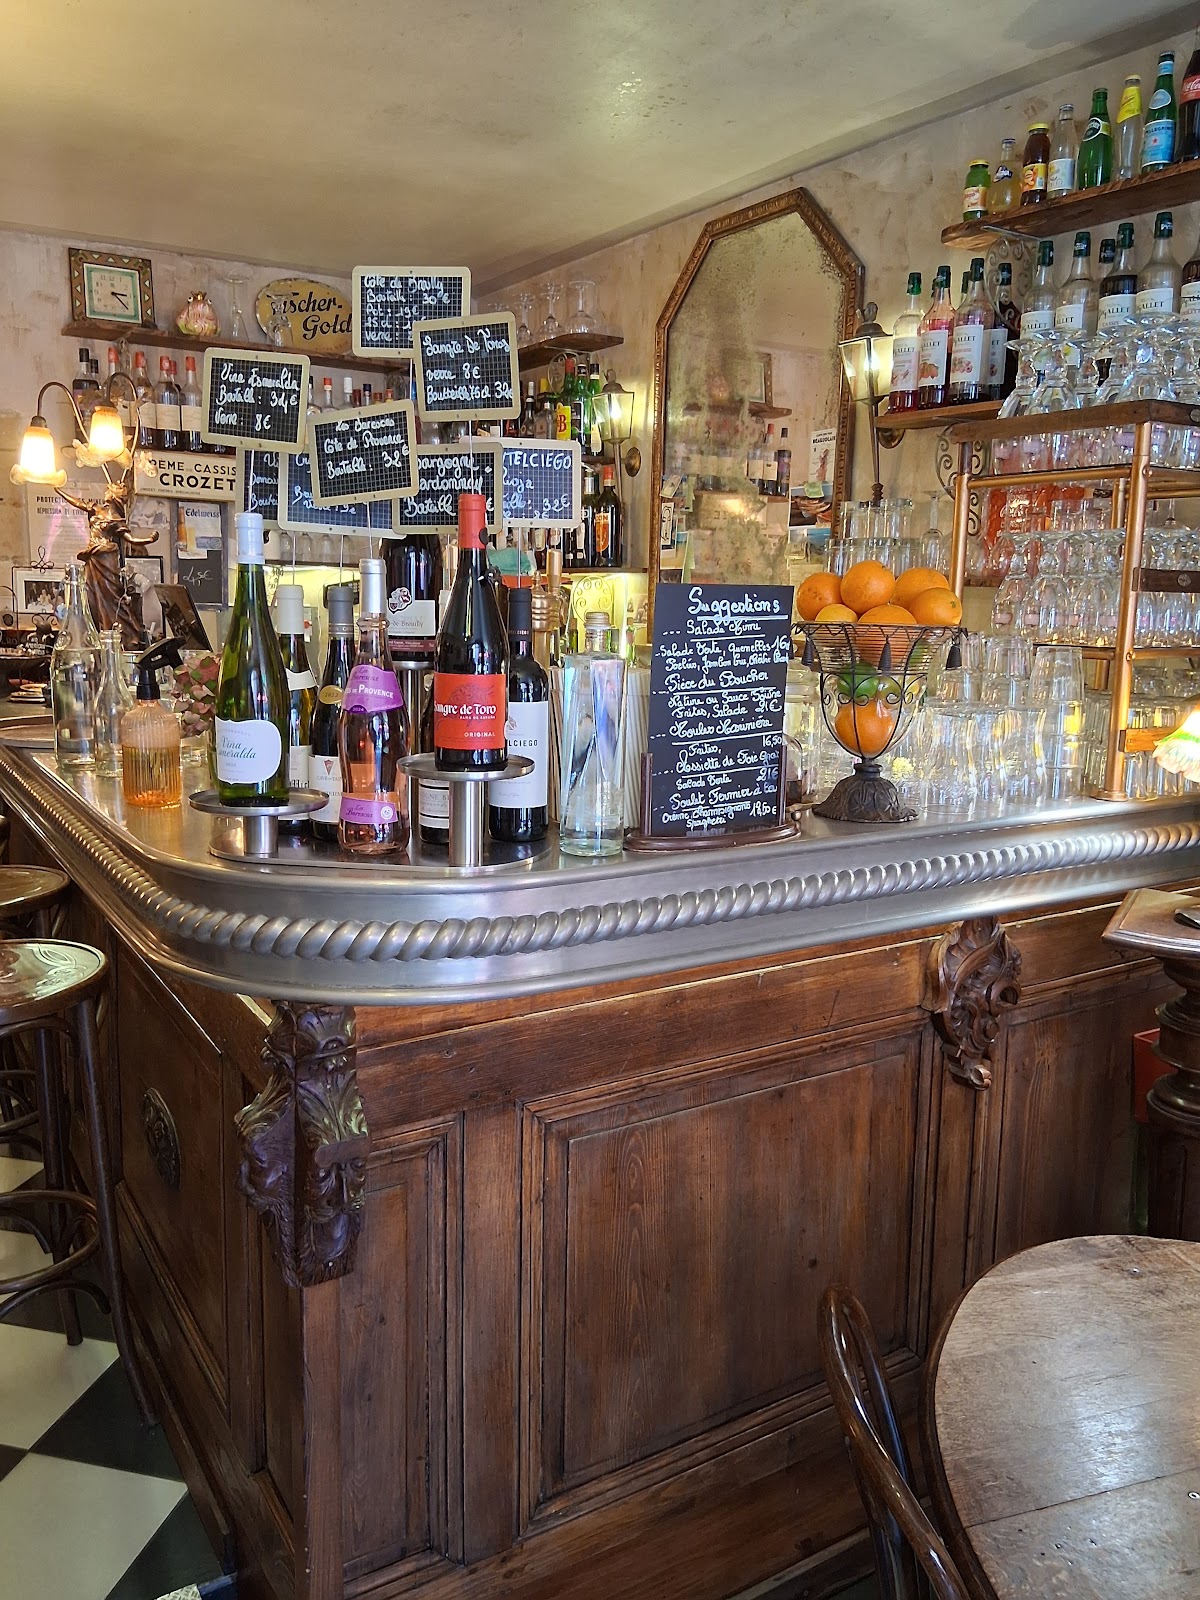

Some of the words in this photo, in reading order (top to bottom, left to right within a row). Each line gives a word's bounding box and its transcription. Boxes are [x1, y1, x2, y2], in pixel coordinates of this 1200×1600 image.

[422, 293, 437, 304] 30
[302, 314, 352, 341] Gold
[362, 430, 404, 448] Provence
[502, 450, 572, 470] TELCIEGO
[194, 464, 237, 476] CASSIS
[159, 472, 236, 491] CROZET
[419, 475, 483, 495] ardonnay
[185, 508, 220, 518] Edelweiss
[687, 586, 780, 625] Suggestions
[687, 619, 725, 635] Salade
[660, 642, 694, 657] Salade
[698, 674, 715, 689] du
[719, 669, 769, 687] Boucher
[358, 684, 394, 699] PROVENCE
[668, 694, 704, 708] Nature
[706, 696, 719, 705] ou
[721, 691, 749, 703] Sauce
[434, 701, 458, 716] Sangre
[460, 704, 473, 715] de
[473, 703, 497, 715] Toro
[712, 703, 748, 718] Salade
[669, 720, 714, 738] Moules
[508, 739, 538, 747] LCIEGO
[676, 750, 721, 773] Assiette
[722, 755, 735, 767] de
[737, 749, 759, 765] Foie
[676, 776, 705, 791] Salade
[707, 774, 732, 787] Verte
[669, 793, 706, 810] Poulet
[708, 785, 752, 804] Fermier
[753, 783, 762, 795] à
